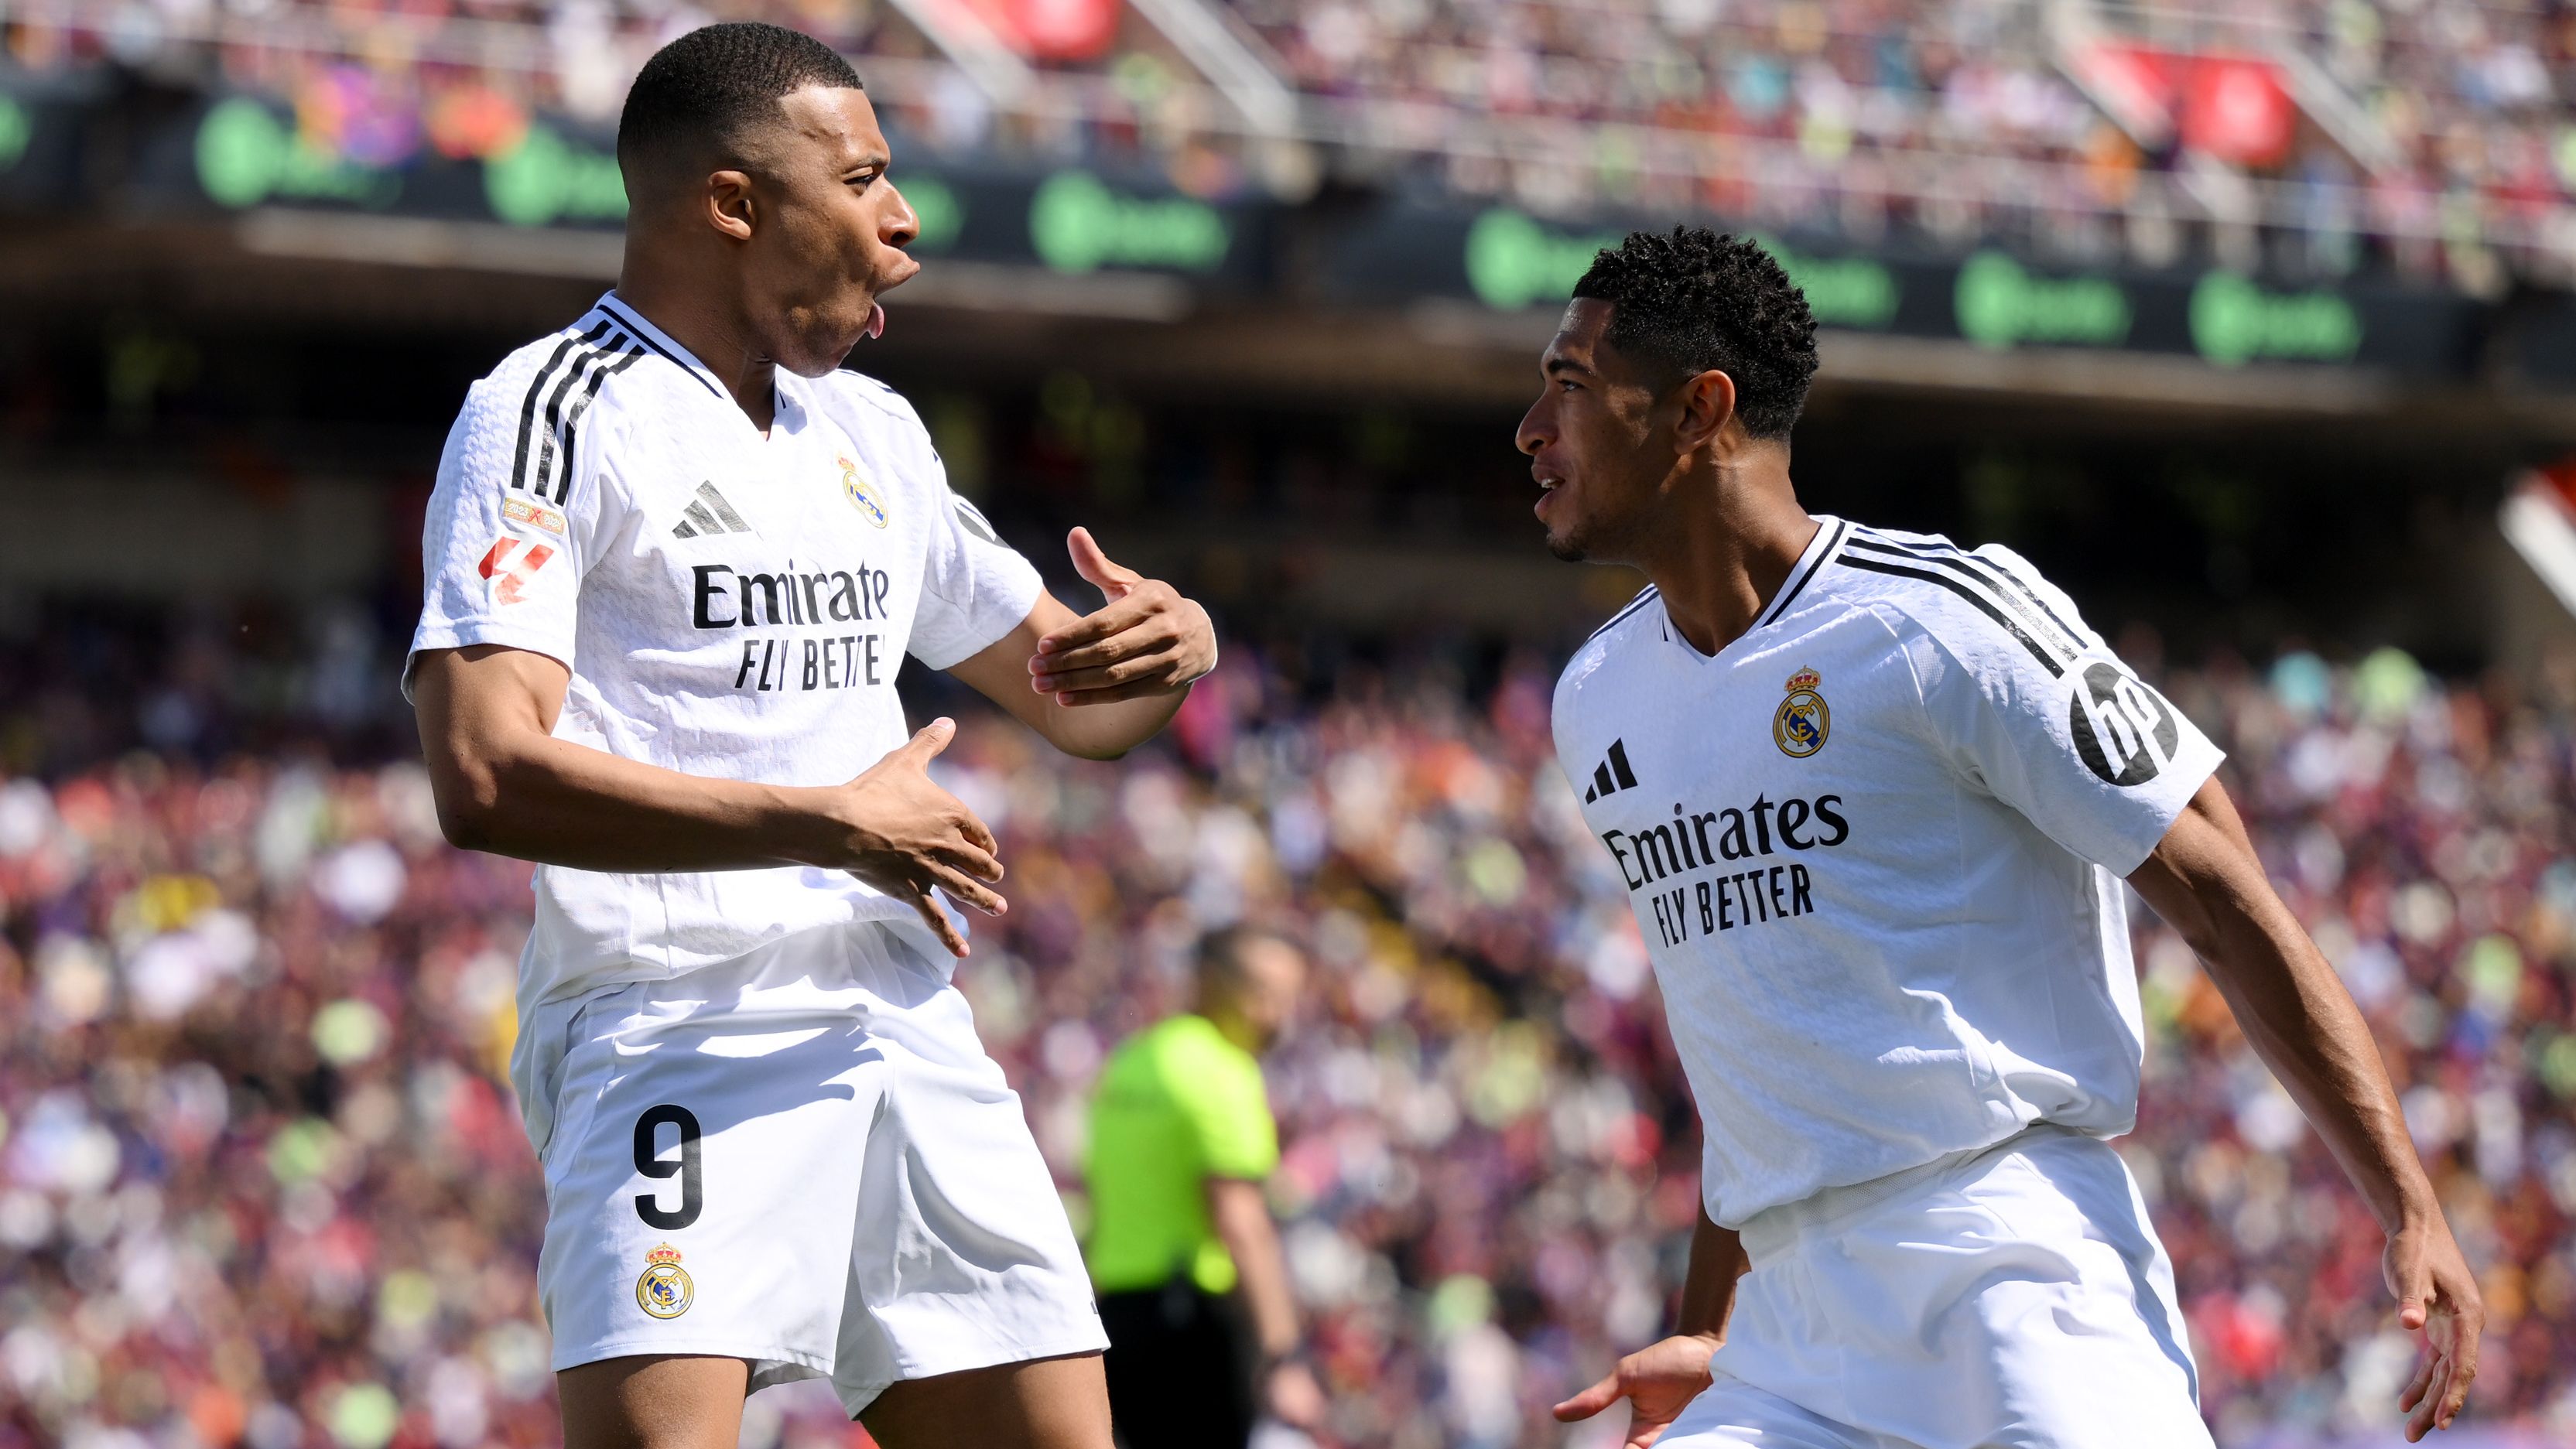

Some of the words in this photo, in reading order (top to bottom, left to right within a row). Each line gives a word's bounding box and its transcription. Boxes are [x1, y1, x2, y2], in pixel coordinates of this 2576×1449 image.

[691, 559, 889, 629] Emirate
[735, 639, 789, 691] FLY
[802, 634, 885, 691] BETTE
[2073, 670, 2172, 783] hp
[1602, 791, 1849, 891] Emirates
[1652, 887, 1687, 948] FLY
[1695, 864, 1814, 935] BETTER
[633, 1103, 703, 1231] 9
